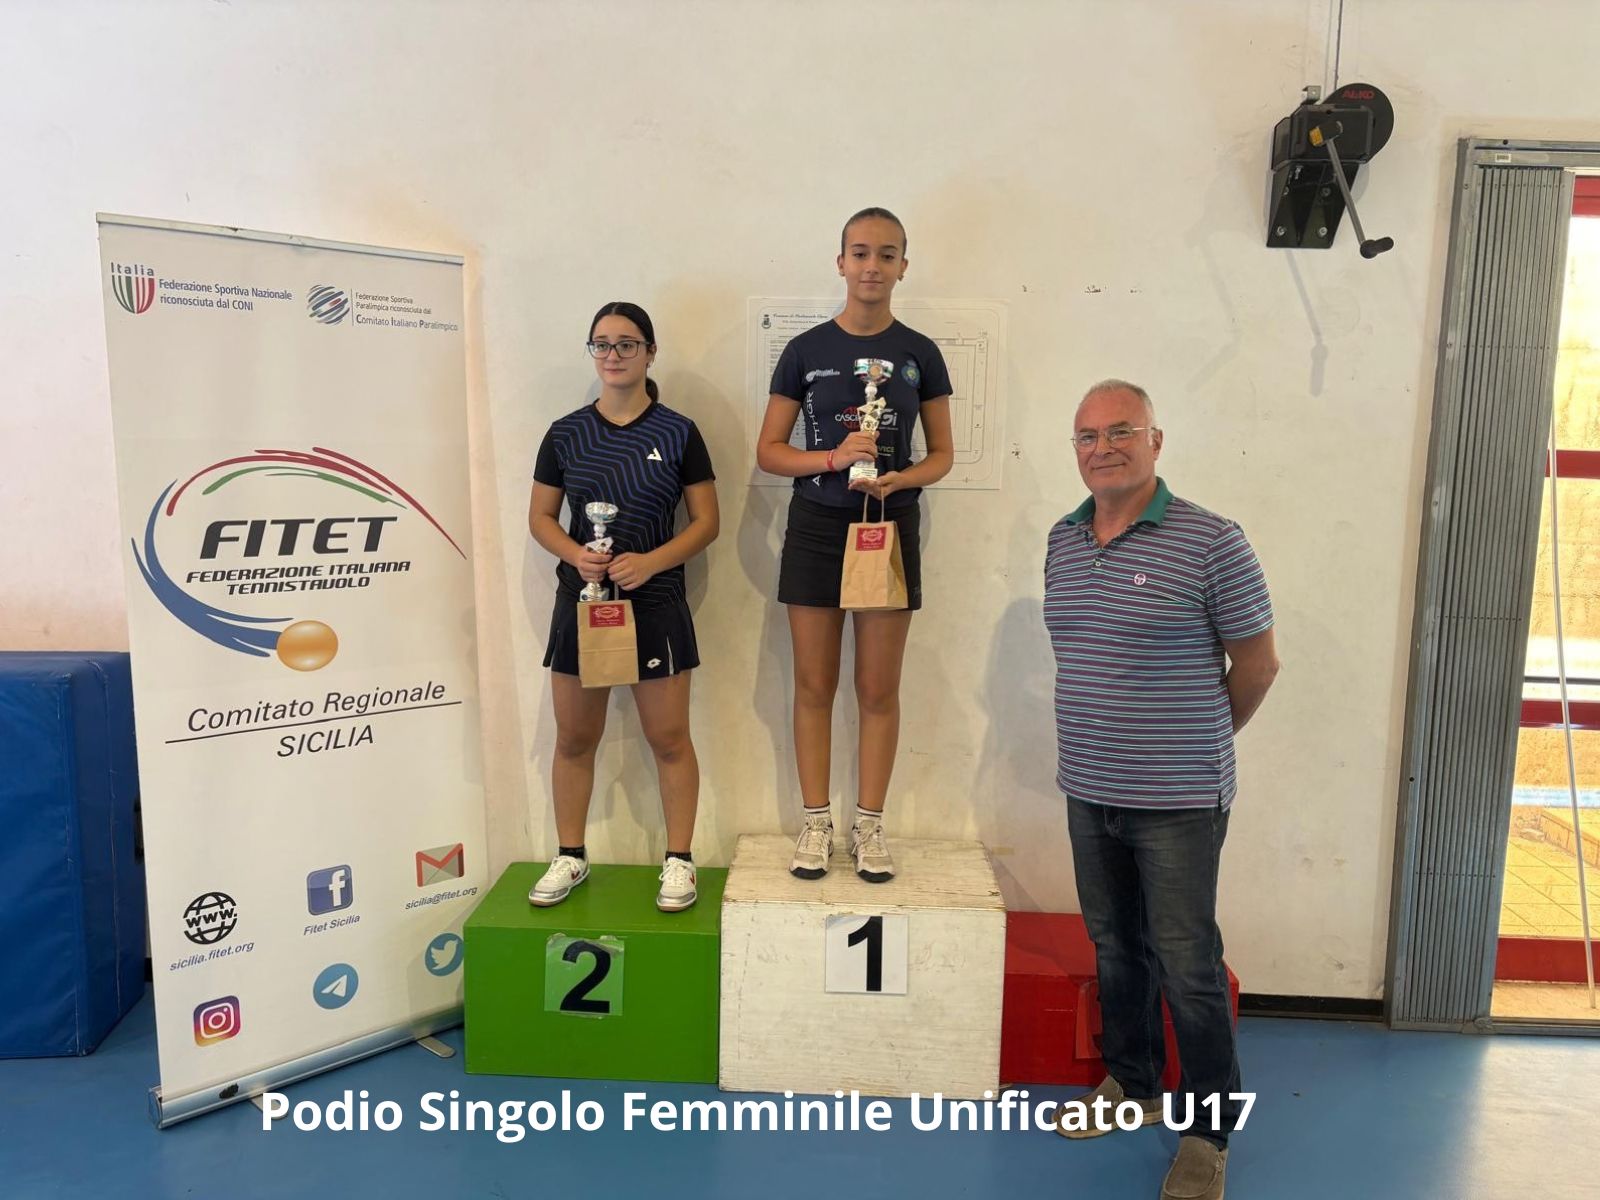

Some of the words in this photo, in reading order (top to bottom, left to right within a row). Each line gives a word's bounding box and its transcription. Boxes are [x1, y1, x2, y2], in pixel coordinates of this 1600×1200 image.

[111, 261, 154, 276] Italia
[159, 279, 212, 293] Federazione
[214, 284, 249, 297] Sportiva
[251, 287, 292, 300] Nazionale
[355, 292, 389, 301] Federazione
[390, 295, 413, 304] Sportiva
[160, 294, 214, 308] riconosciuta
[216, 299, 230, 309] dal
[232, 300, 253, 311] CONI
[356, 301, 389, 311] Paralimpica
[390, 305, 422, 314] riconosciuta
[356, 314, 389, 326] Comitato
[391, 316, 417, 328] Italiano
[419, 319, 458, 331] Paralimpico
[199, 516, 398, 560] FITET
[186, 565, 324, 583] FEDERAZIONE
[328, 561, 411, 576] ITALIANA
[187, 700, 314, 732] Comitato
[323, 681, 445, 714] Regionale
[276, 724, 374, 757] SICILIA
[405, 887, 478, 910] sicilia@fitet.org
[303, 922, 327, 936] Fitet
[329, 914, 360, 929] Sicilia
[169, 940, 255, 971] sicilia.fitet.org
[847, 915, 883, 991] 1
[559, 940, 612, 1014] 2
